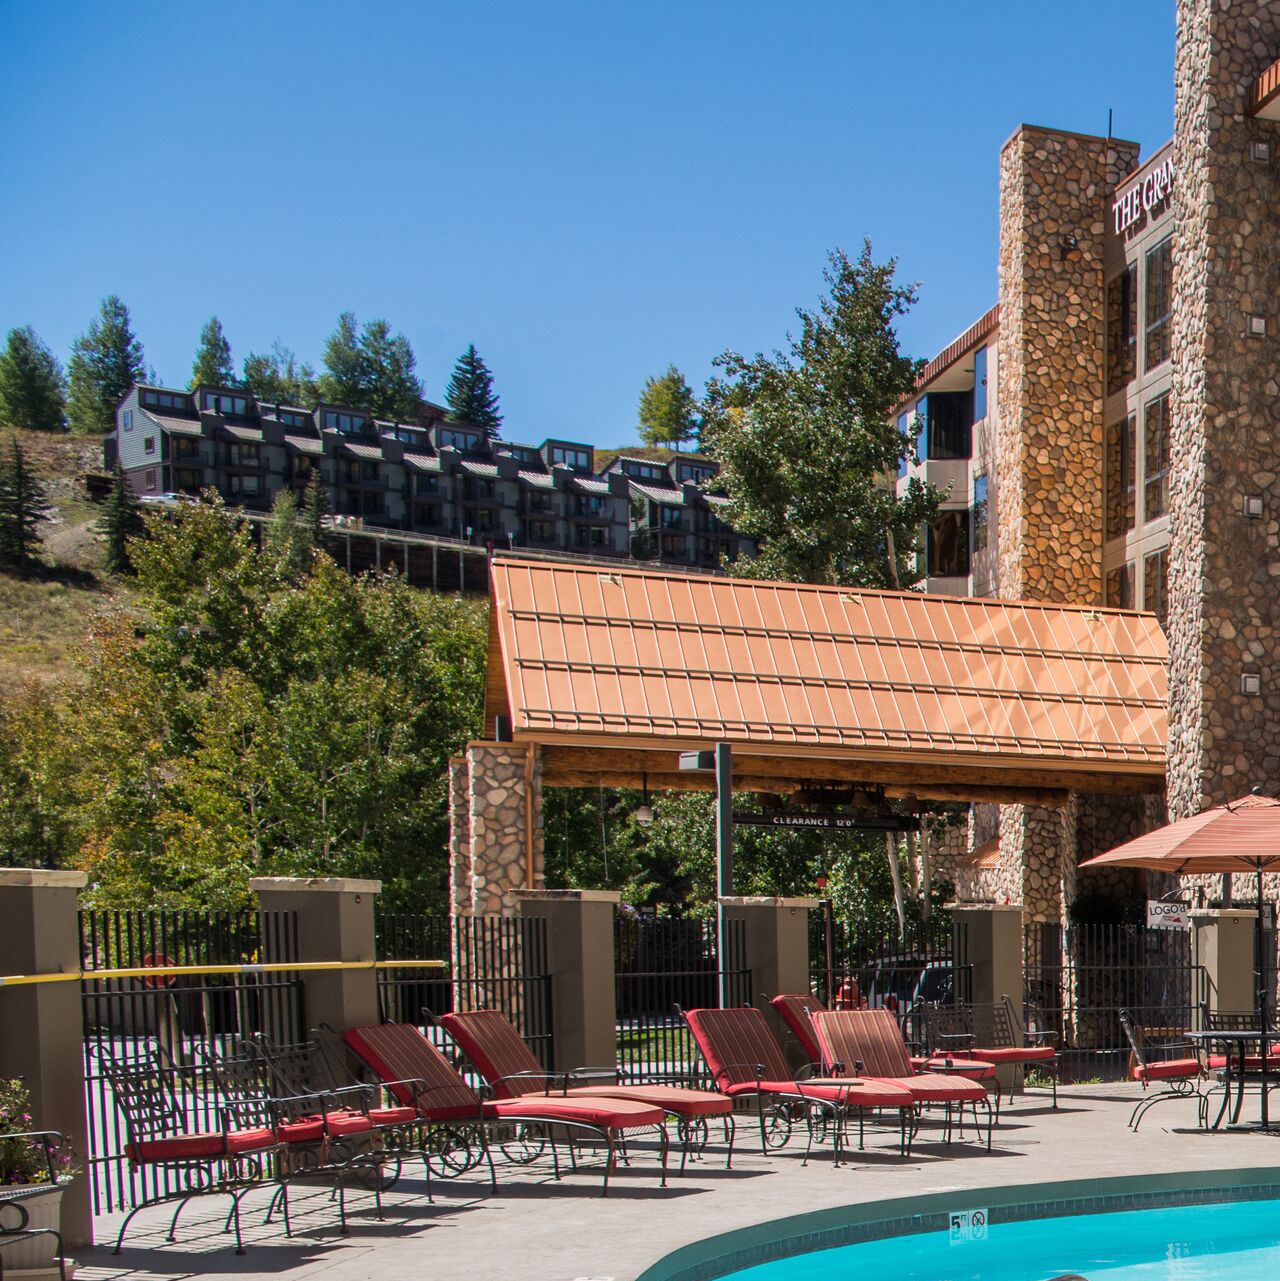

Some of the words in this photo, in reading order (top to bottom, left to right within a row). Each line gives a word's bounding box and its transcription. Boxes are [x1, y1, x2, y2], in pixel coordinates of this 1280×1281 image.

[1113, 184, 1140, 235] THE
[773, 817, 829, 826] CLEARANCE
[1149, 904, 1186, 916] LOGO'd
[951, 1215, 960, 1229] 5
